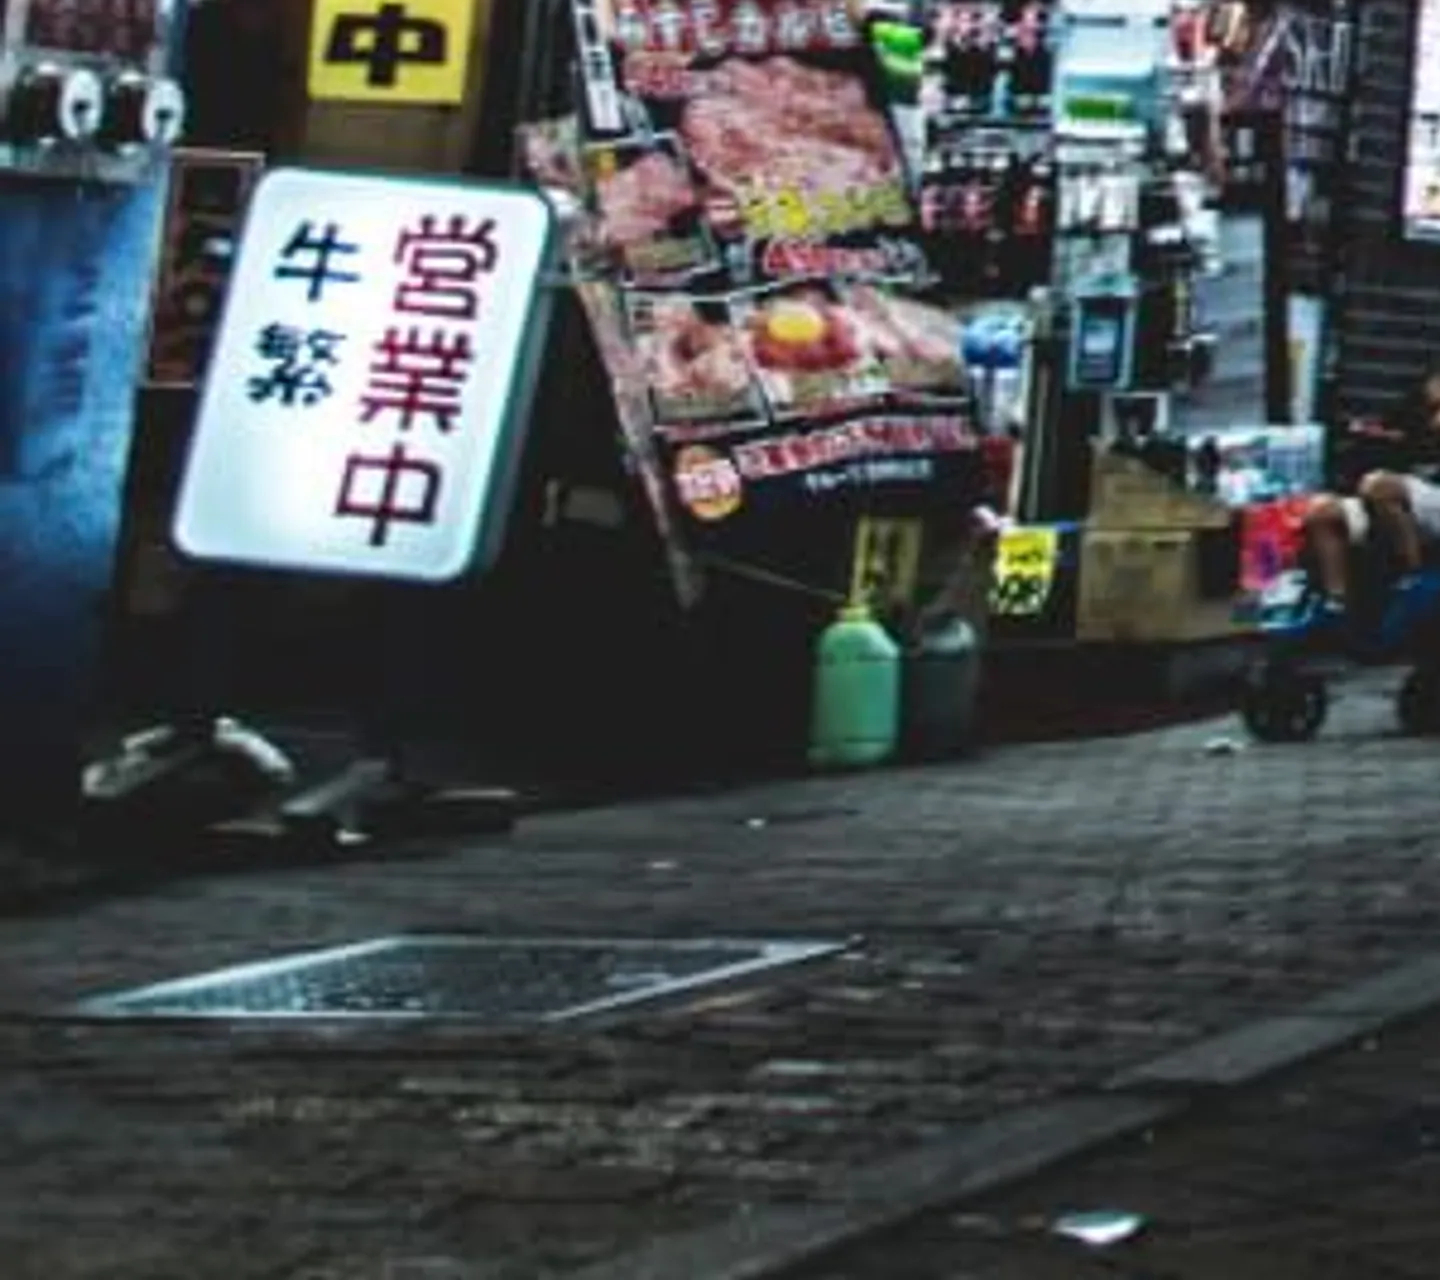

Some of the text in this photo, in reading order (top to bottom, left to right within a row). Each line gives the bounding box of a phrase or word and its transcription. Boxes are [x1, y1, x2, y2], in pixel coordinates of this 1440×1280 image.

[245, 219, 363, 409] 牛繁
[332, 214, 499, 548] 営業中
